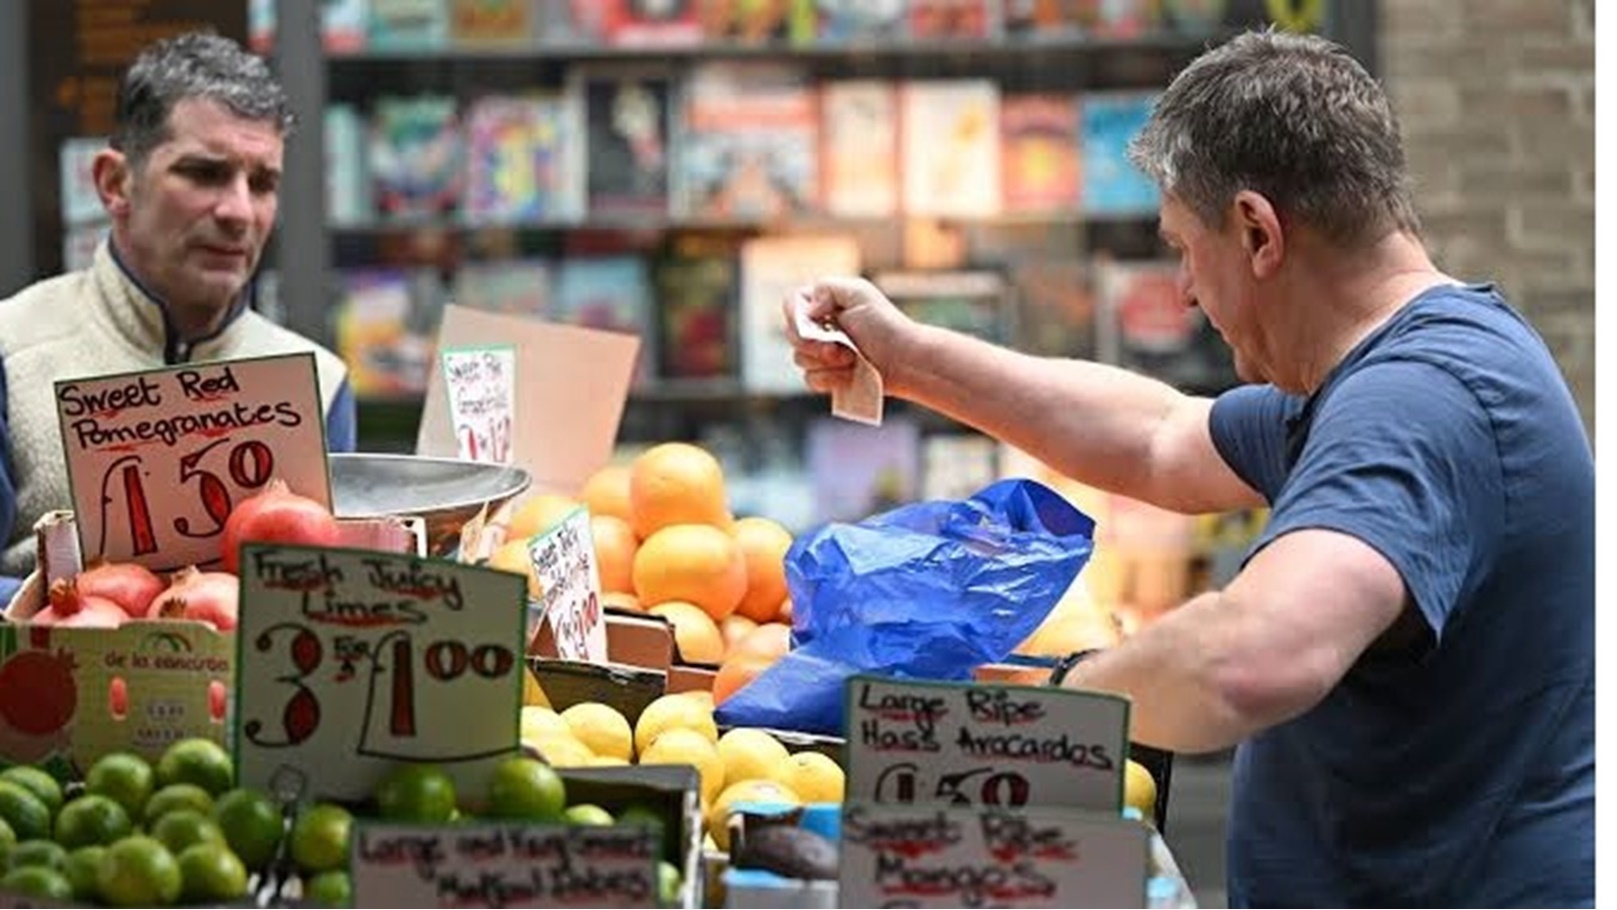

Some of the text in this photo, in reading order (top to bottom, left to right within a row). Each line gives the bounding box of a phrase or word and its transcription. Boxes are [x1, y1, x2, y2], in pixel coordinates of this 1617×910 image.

[59, 367, 240, 416] Sweet Red
[72, 402, 301, 449] Pomegranates
[252, 550, 464, 611] Fresh Juicy
[301, 590, 428, 625] Limes
[244, 622, 324, 748] 3
[858, 684, 1046, 732] Large Ripe
[861, 720, 941, 754] Hass
